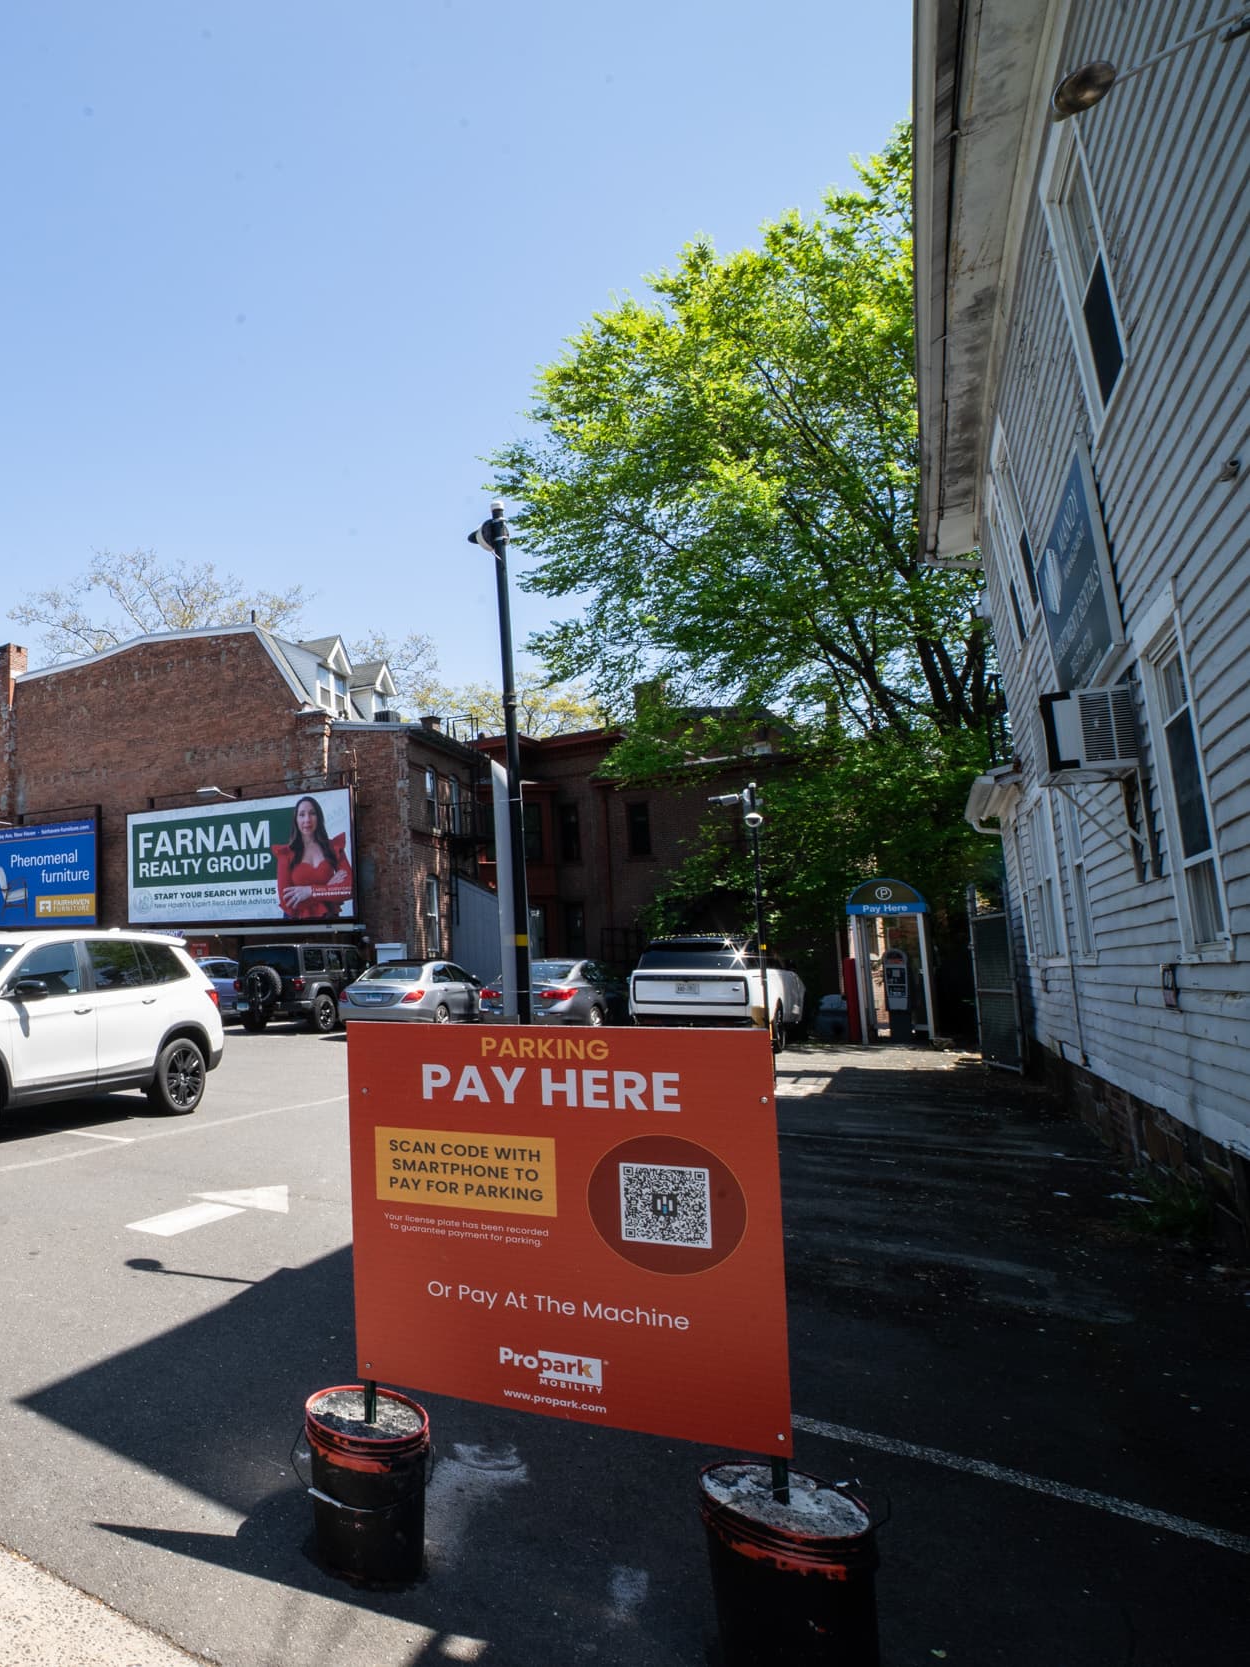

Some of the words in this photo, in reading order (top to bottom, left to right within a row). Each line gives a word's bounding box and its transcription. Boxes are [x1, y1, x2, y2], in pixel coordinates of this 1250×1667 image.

[138, 820, 270, 859] FARNAM
[10, 849, 78, 868] Phenomenal
[139, 858, 203, 878] REALTY
[206, 852, 272, 873] GROUP
[41, 868, 90, 883] furniture
[154, 892, 179, 900] START
[180, 890, 202, 899] YOUR
[203, 889, 237, 898] SEARCH
[238, 888, 263, 897] WITH
[264, 887, 277, 895] US
[862, 905, 881, 913] Pay
[884, 904, 908, 912] Here
[480, 1037, 609, 1061] PARKING
[421, 1063, 526, 1105] PAY
[541, 1069, 681, 1112] HERE
[389, 1139, 435, 1154] SCAN
[440, 1143, 489, 1158] CODE
[494, 1146, 541, 1162] WITH
[392, 1158, 509, 1180] SMARTPHONE
[514, 1168, 539, 1182] TO
[389, 1176, 421, 1190] PAY
[426, 1180, 458, 1194] FOR
[464, 1183, 543, 1201] PARKING
[383, 1212, 403, 1221] Your
[405, 1215, 436, 1225] license
[437, 1218, 461, 1229] plate
[462, 1220, 479, 1230] has
[481, 1222, 504, 1232] been
[506, 1225, 549, 1237] recorded
[389, 1222, 399, 1230] to
[401, 1224, 446, 1235] guarantee
[448, 1229, 488, 1240] payment
[490, 1233, 503, 1242] for
[505, 1234, 543, 1247] parking.
[427, 1280, 452, 1298] Or
[458, 1284, 498, 1309] Pay
[504, 1291, 528, 1309] At
[534, 1294, 576, 1315] The
[583, 1301, 689, 1330] Machine
[499, 1346, 593, 1378] Propark
[539, 1378, 603, 1394] MOBILITY
[503, 1389, 607, 1413] www.propark.com
